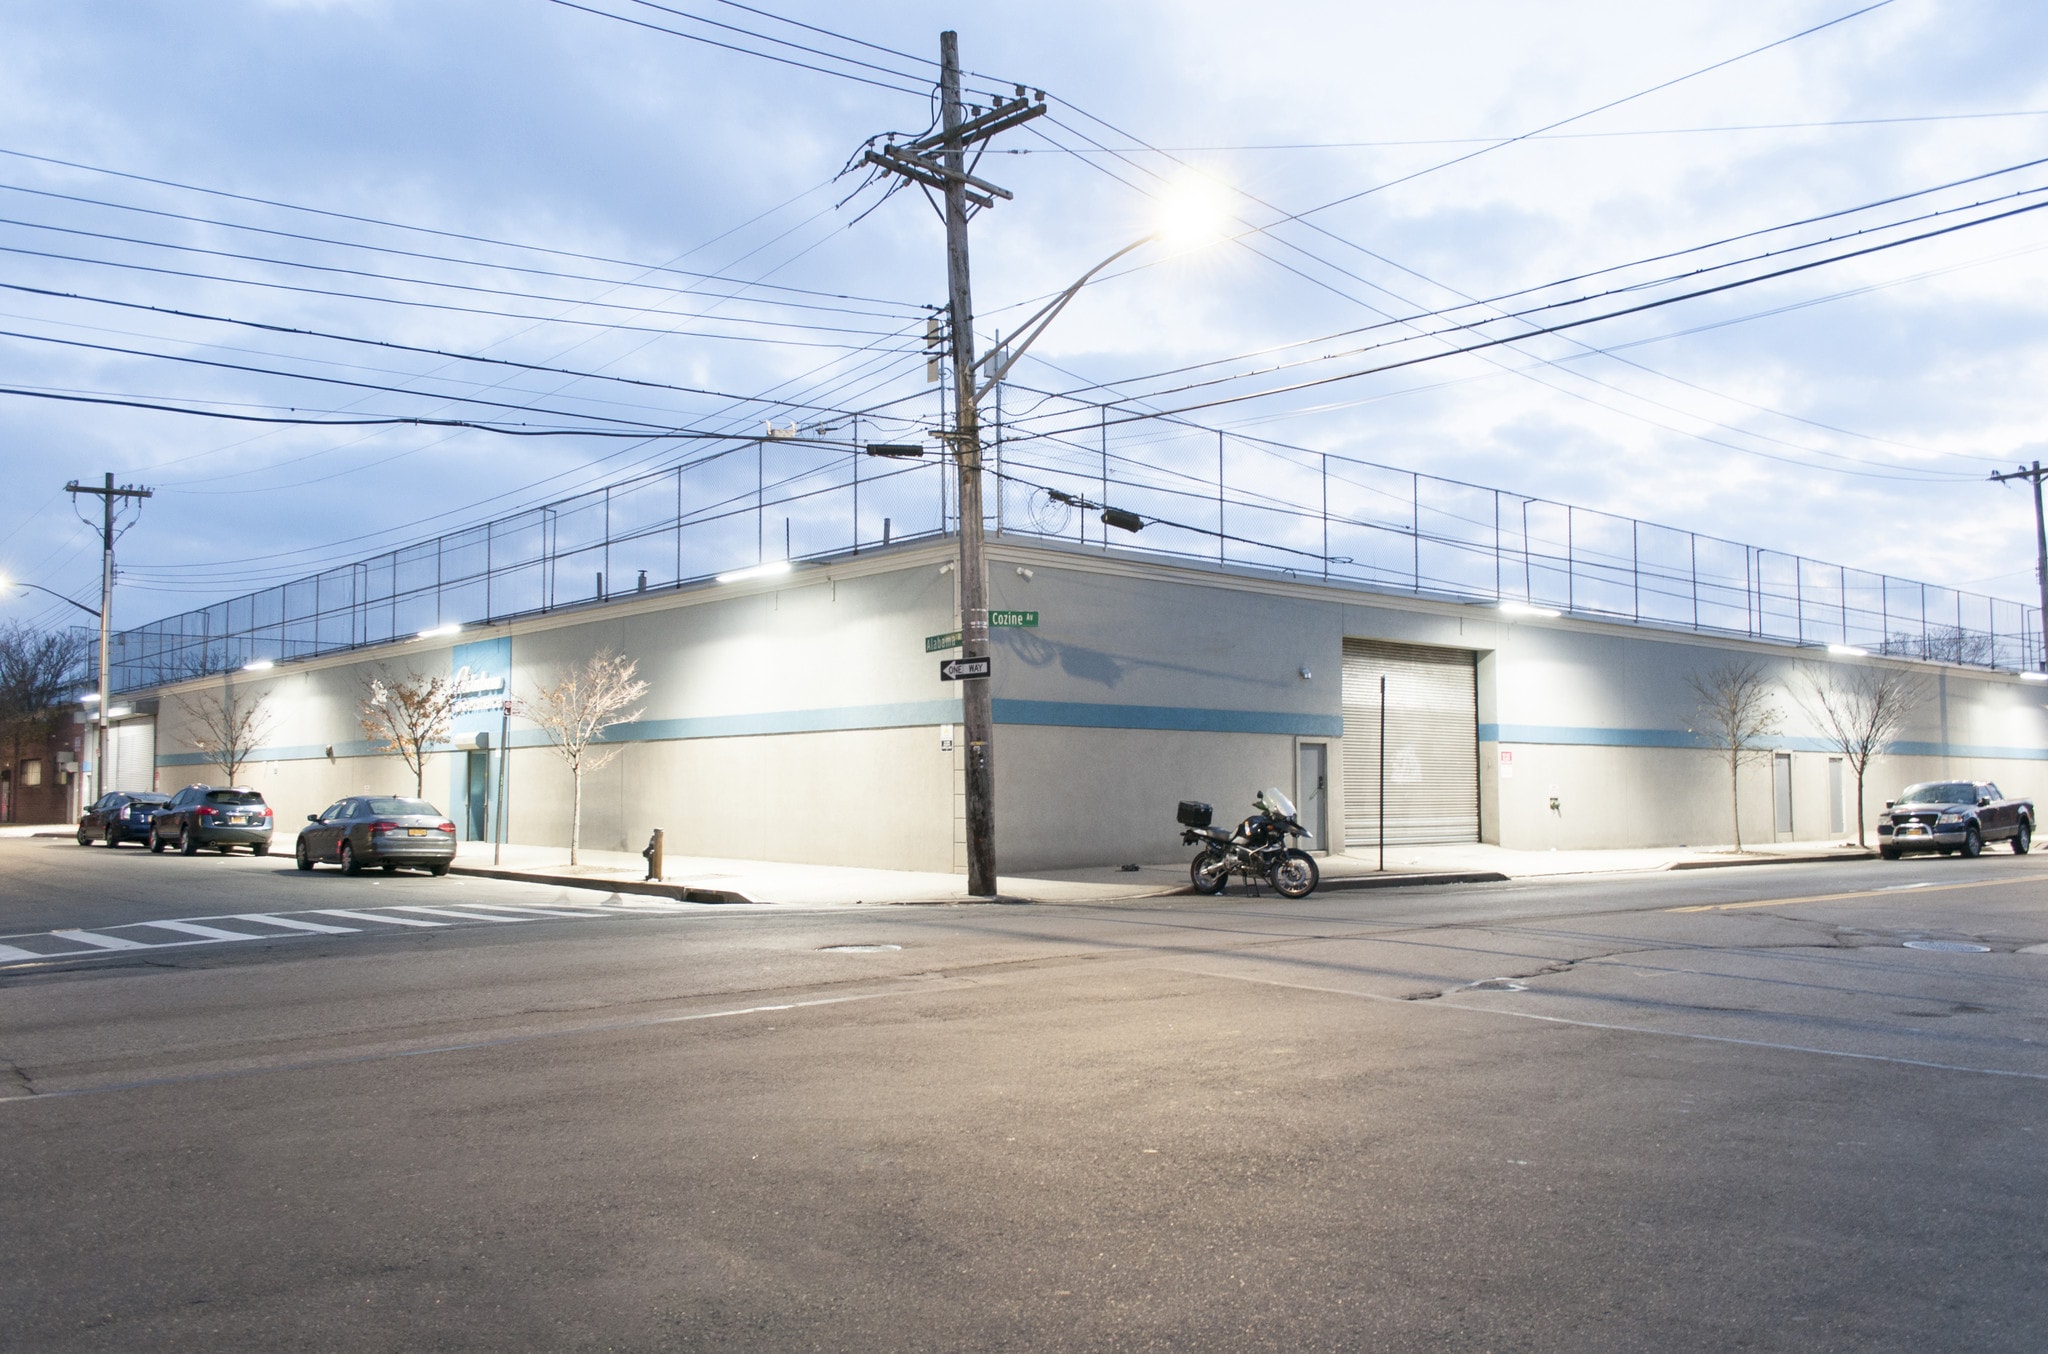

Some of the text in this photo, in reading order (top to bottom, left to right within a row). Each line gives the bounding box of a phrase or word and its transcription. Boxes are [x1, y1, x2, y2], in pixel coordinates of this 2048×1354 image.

[992, 612, 1023, 625] Cozine
[927, 636, 956, 651] Alabama
[948, 664, 983, 674] ONE WAY
